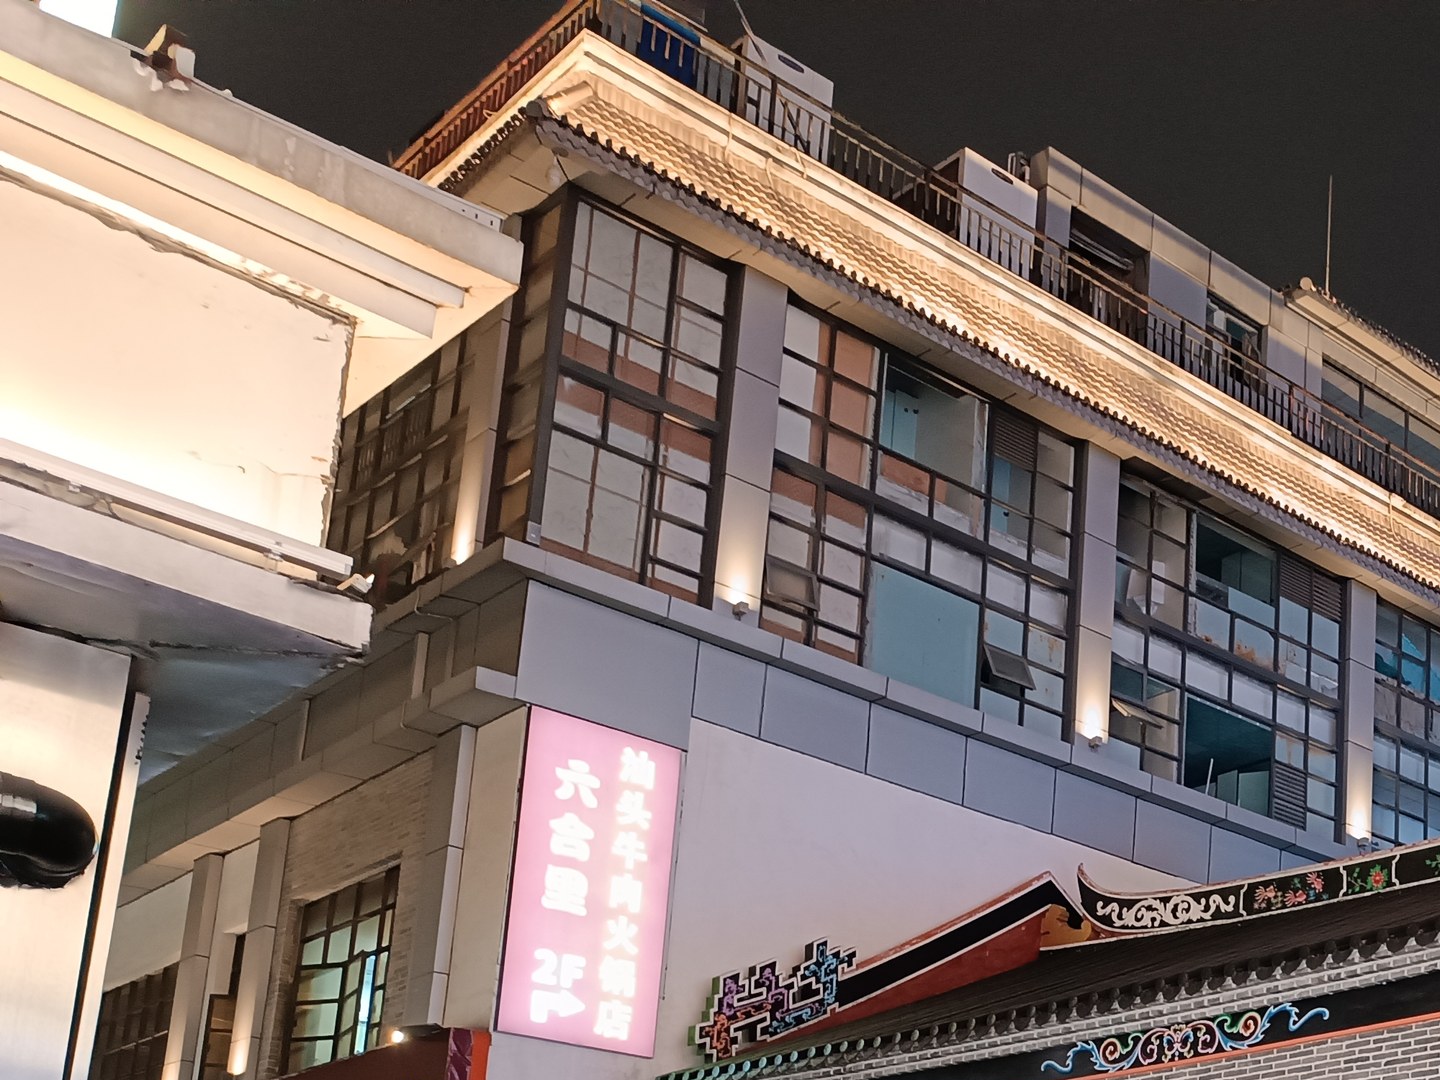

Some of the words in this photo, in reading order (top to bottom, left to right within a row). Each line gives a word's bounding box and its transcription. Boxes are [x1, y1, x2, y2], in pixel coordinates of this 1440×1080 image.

[541, 758, 601, 917] 六合里
[593, 746, 656, 1041] 汕头牛肉火锅店
[531, 948, 587, 989] 2F
